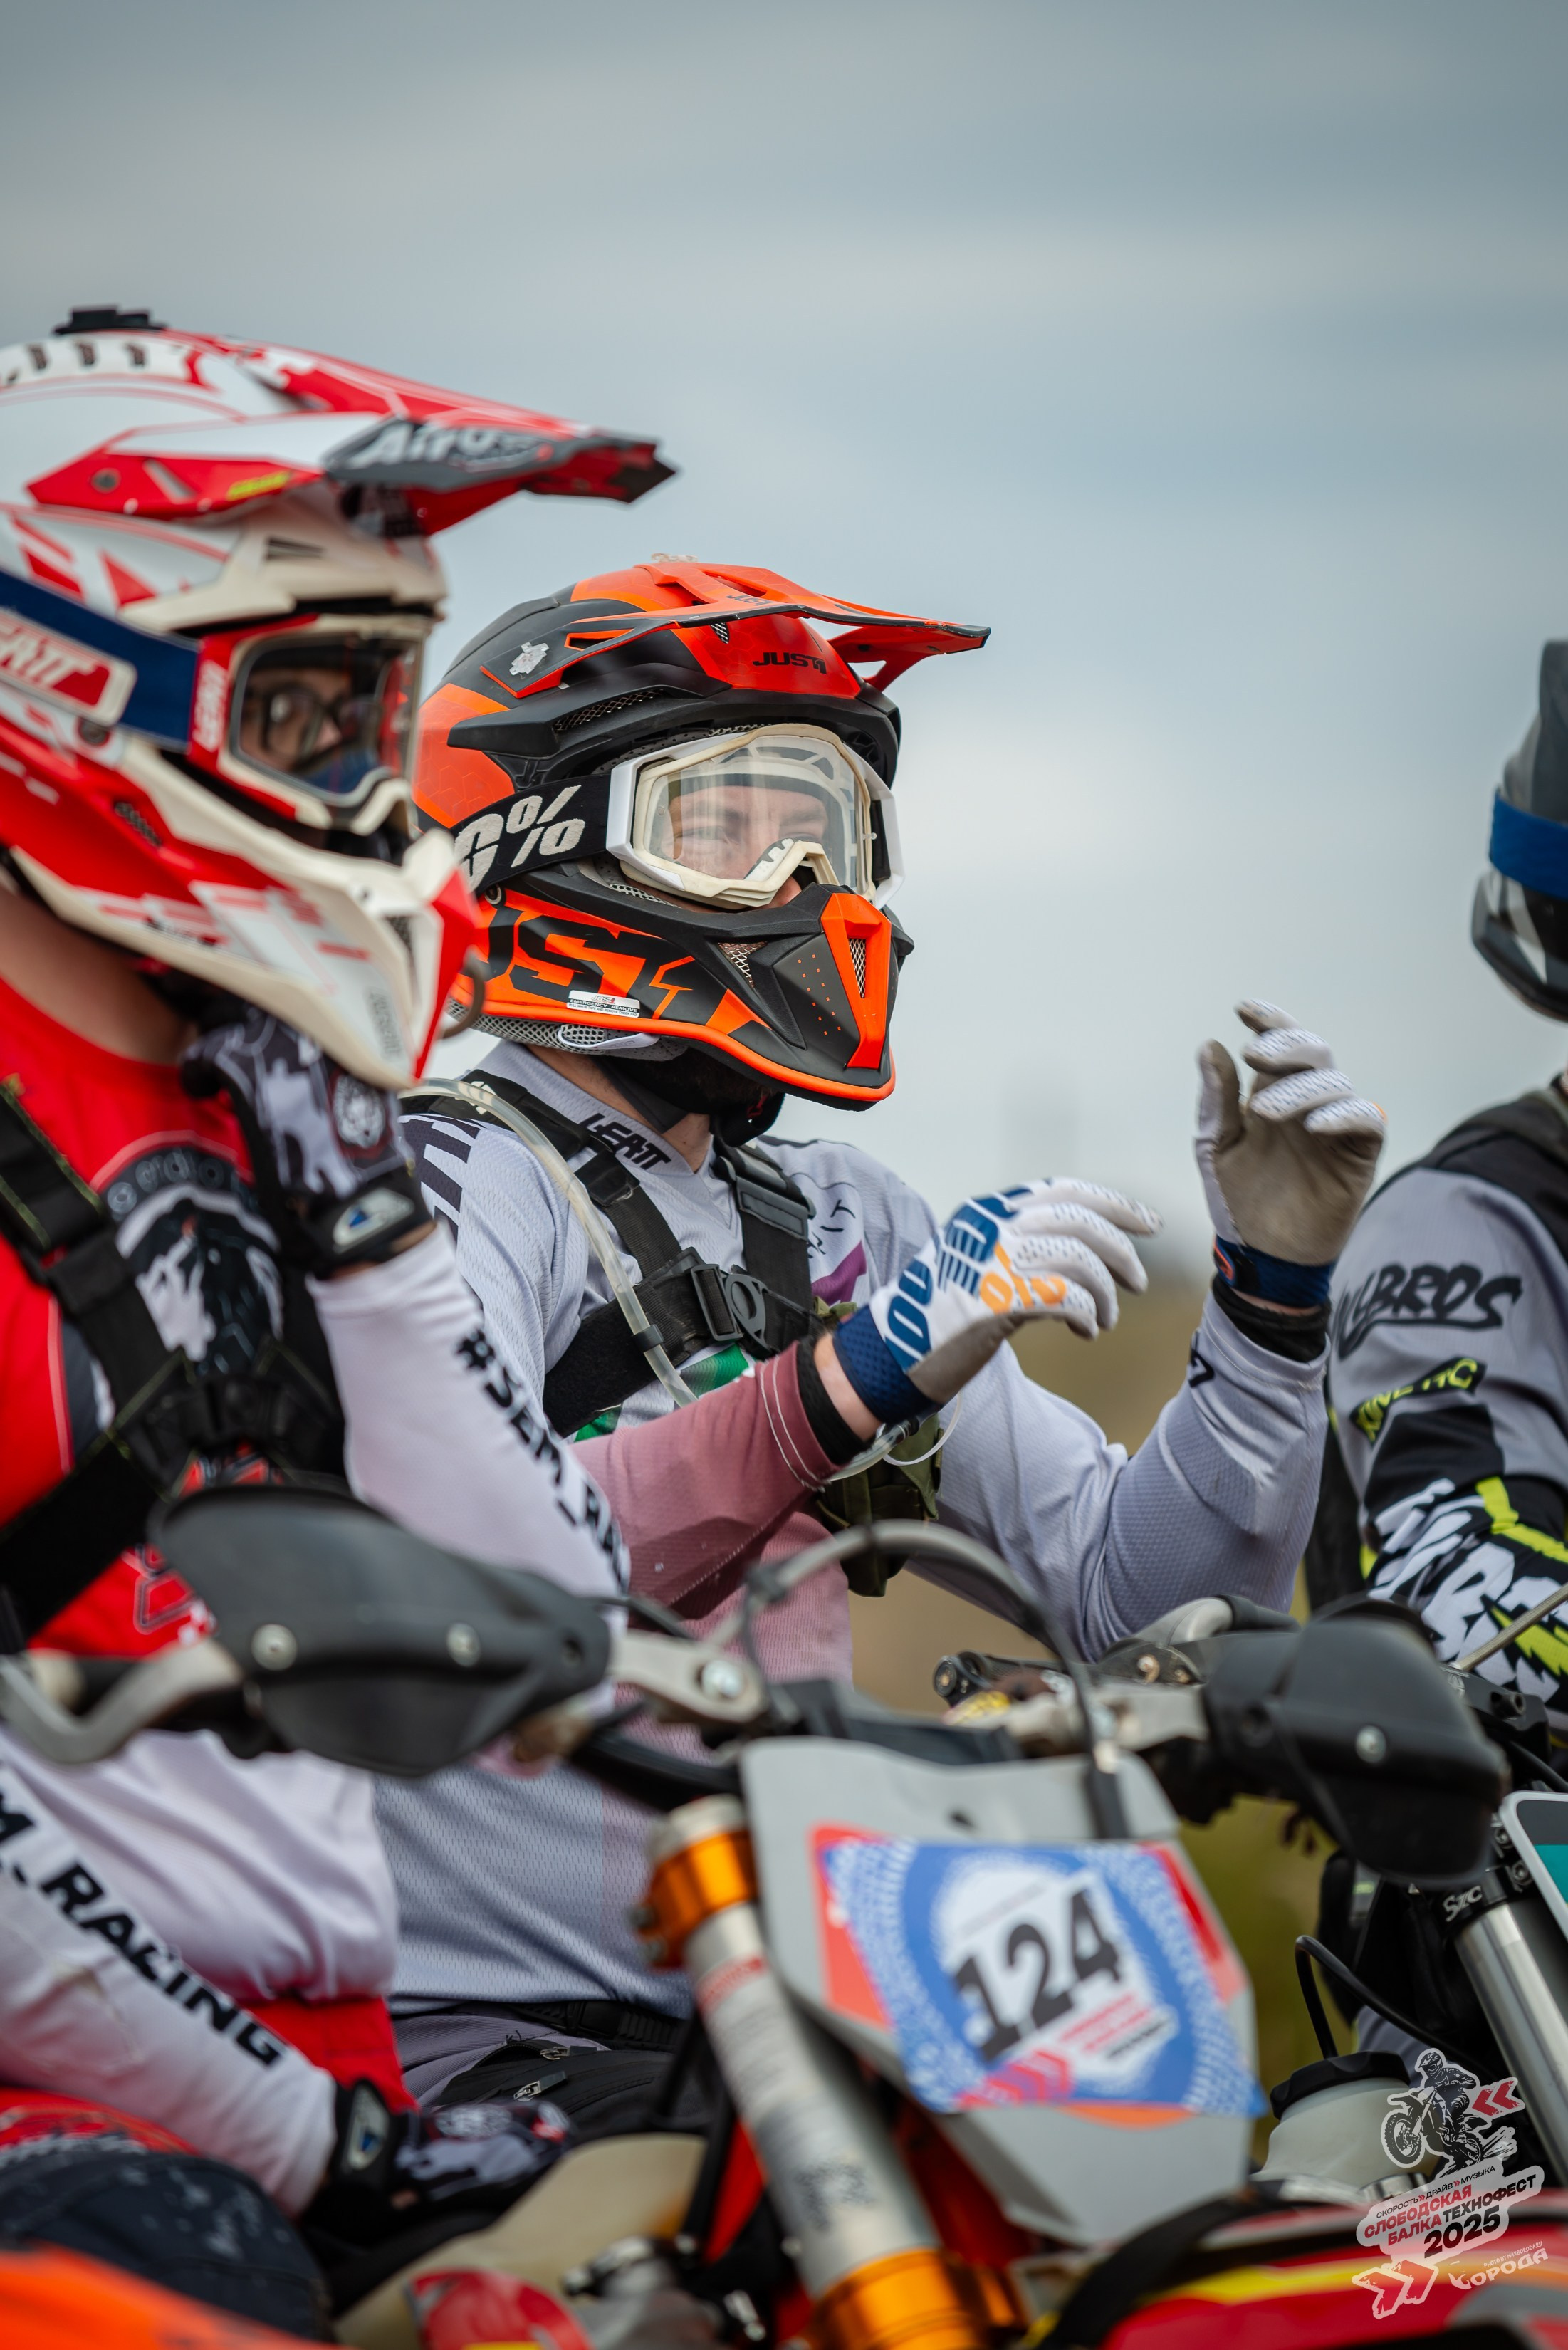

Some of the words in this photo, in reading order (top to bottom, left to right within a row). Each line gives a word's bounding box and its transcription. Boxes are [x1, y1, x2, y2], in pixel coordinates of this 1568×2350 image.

[752, 652, 827, 675] JUST1
[570, 999, 607, 1008] EMERGENCY
[954, 1888, 1121, 2062] 124
